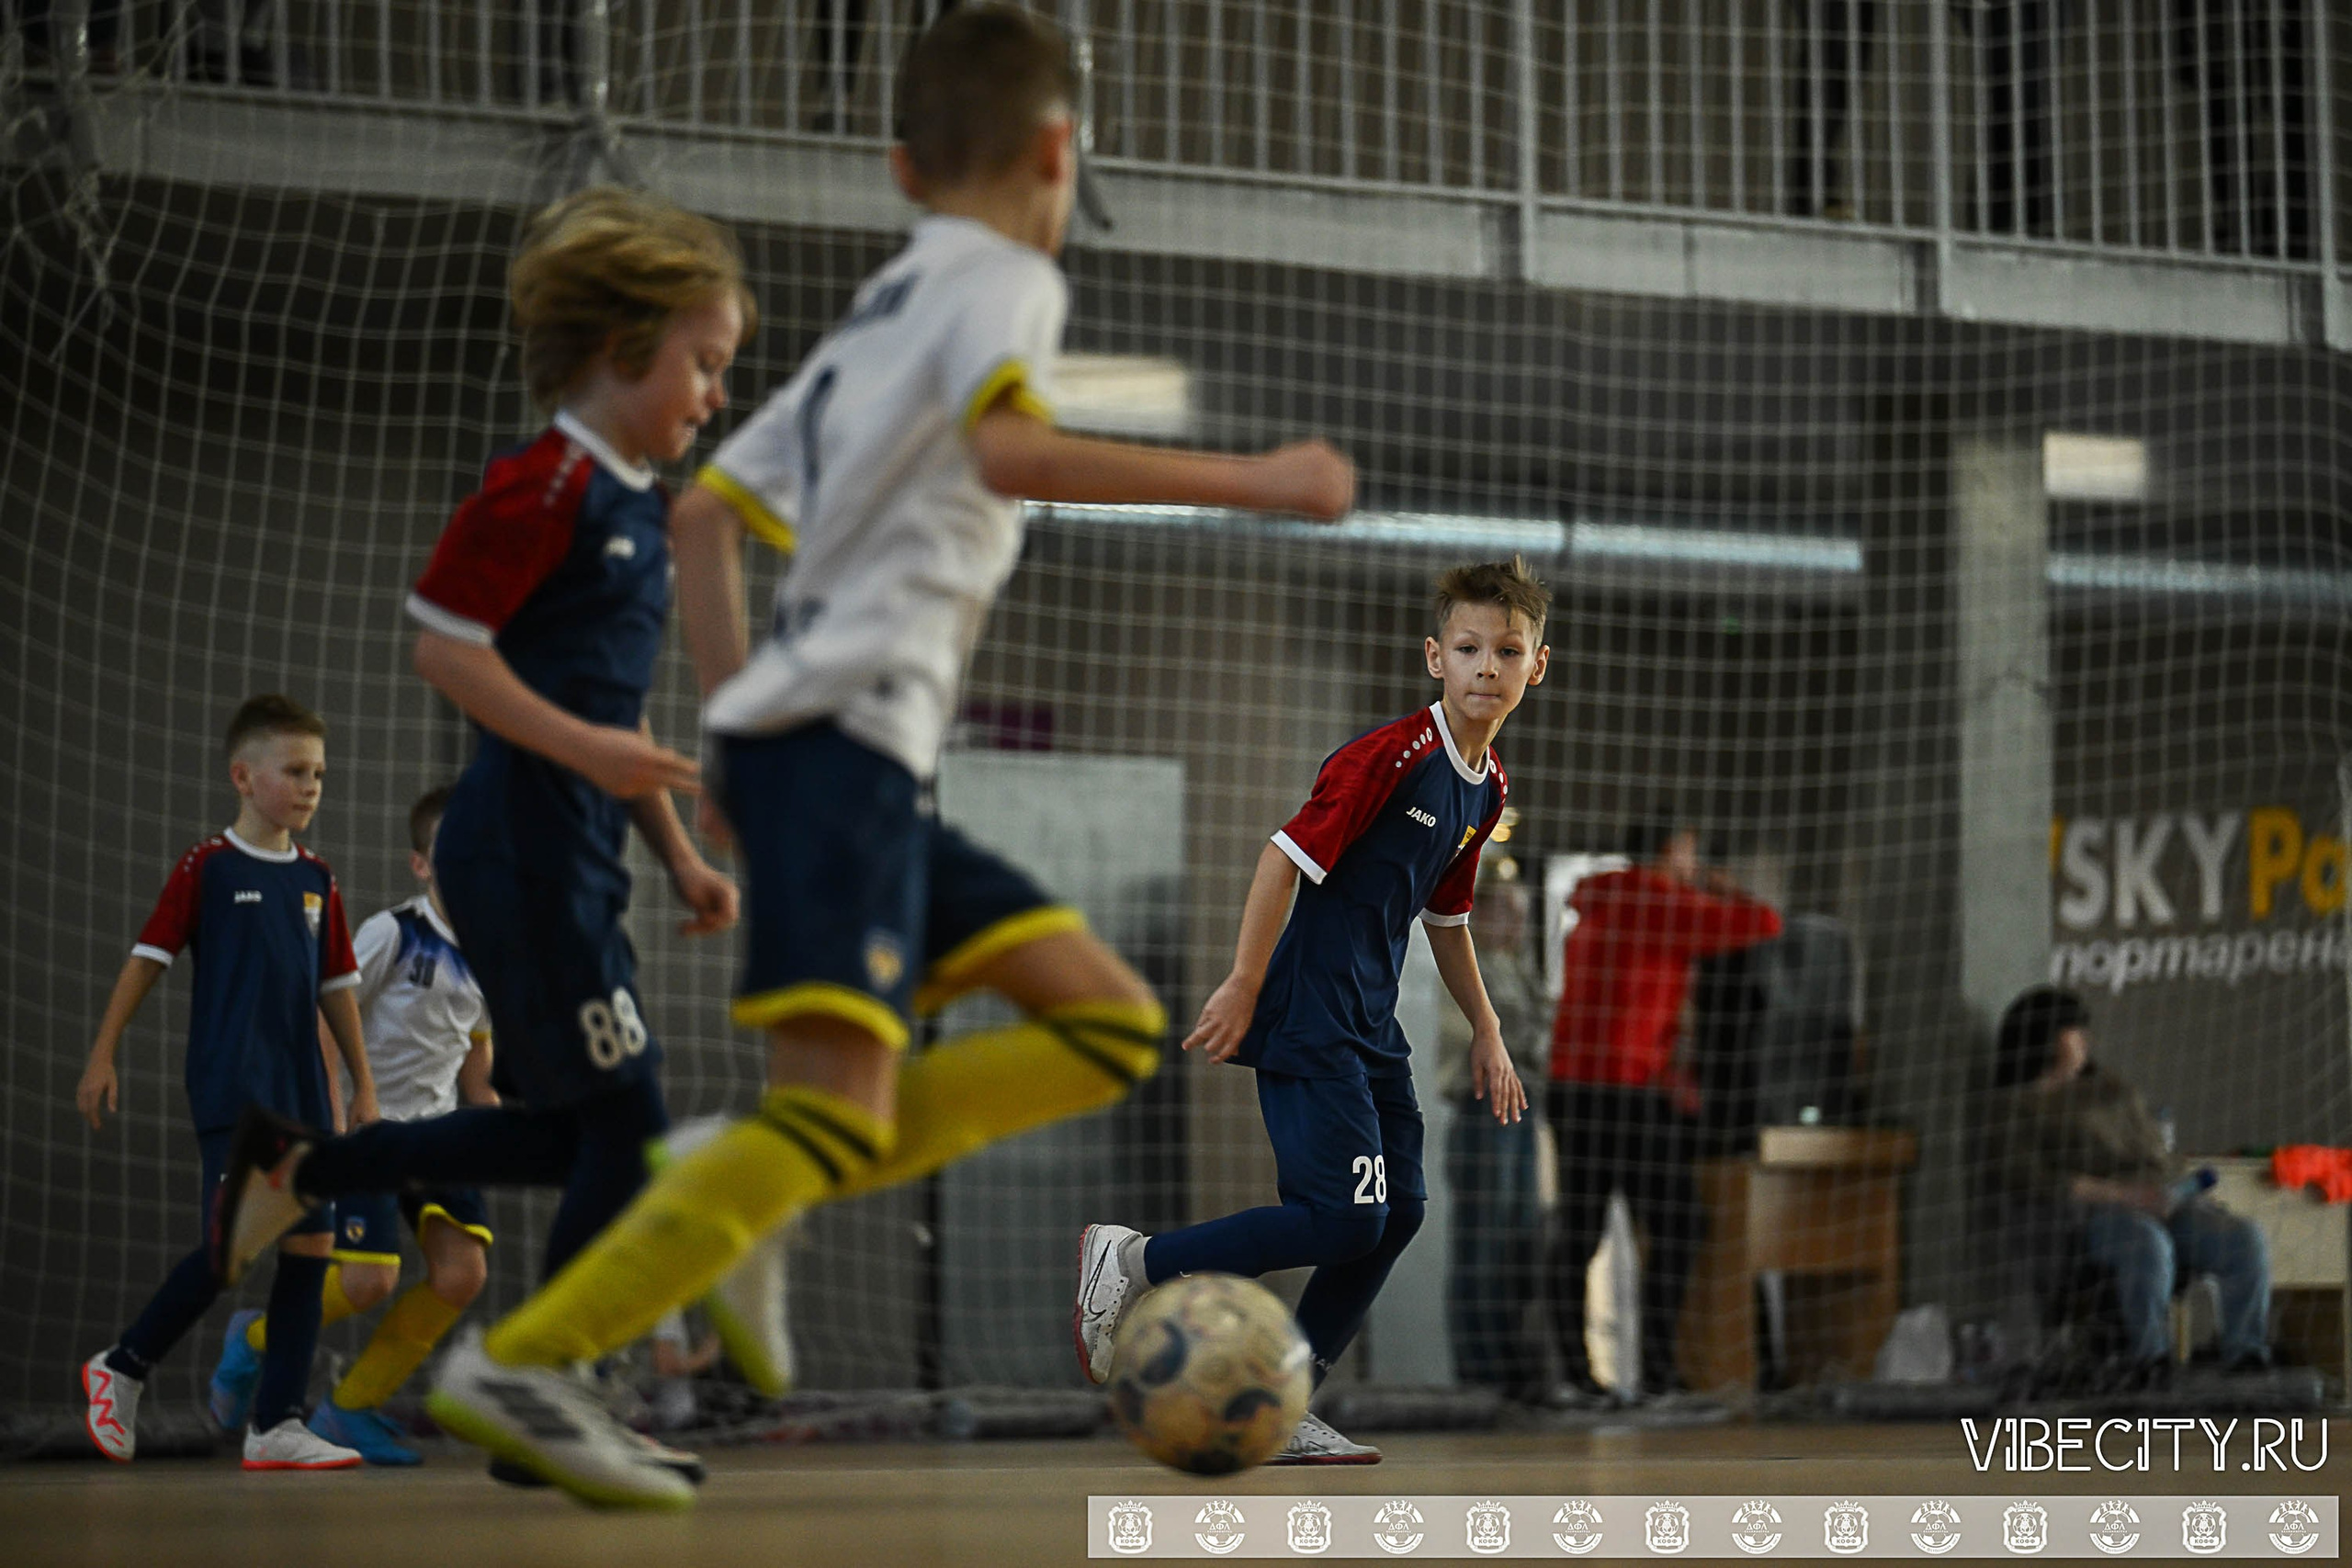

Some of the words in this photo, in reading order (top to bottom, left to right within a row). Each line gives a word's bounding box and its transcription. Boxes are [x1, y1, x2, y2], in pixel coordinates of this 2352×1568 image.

[1406, 806, 1437, 828] JAKO
[2050, 806, 2346, 930] SKYPa
[2048, 929, 2346, 996] портарен
[579, 986, 648, 1069] 88
[1352, 1154, 1387, 1204] 28
